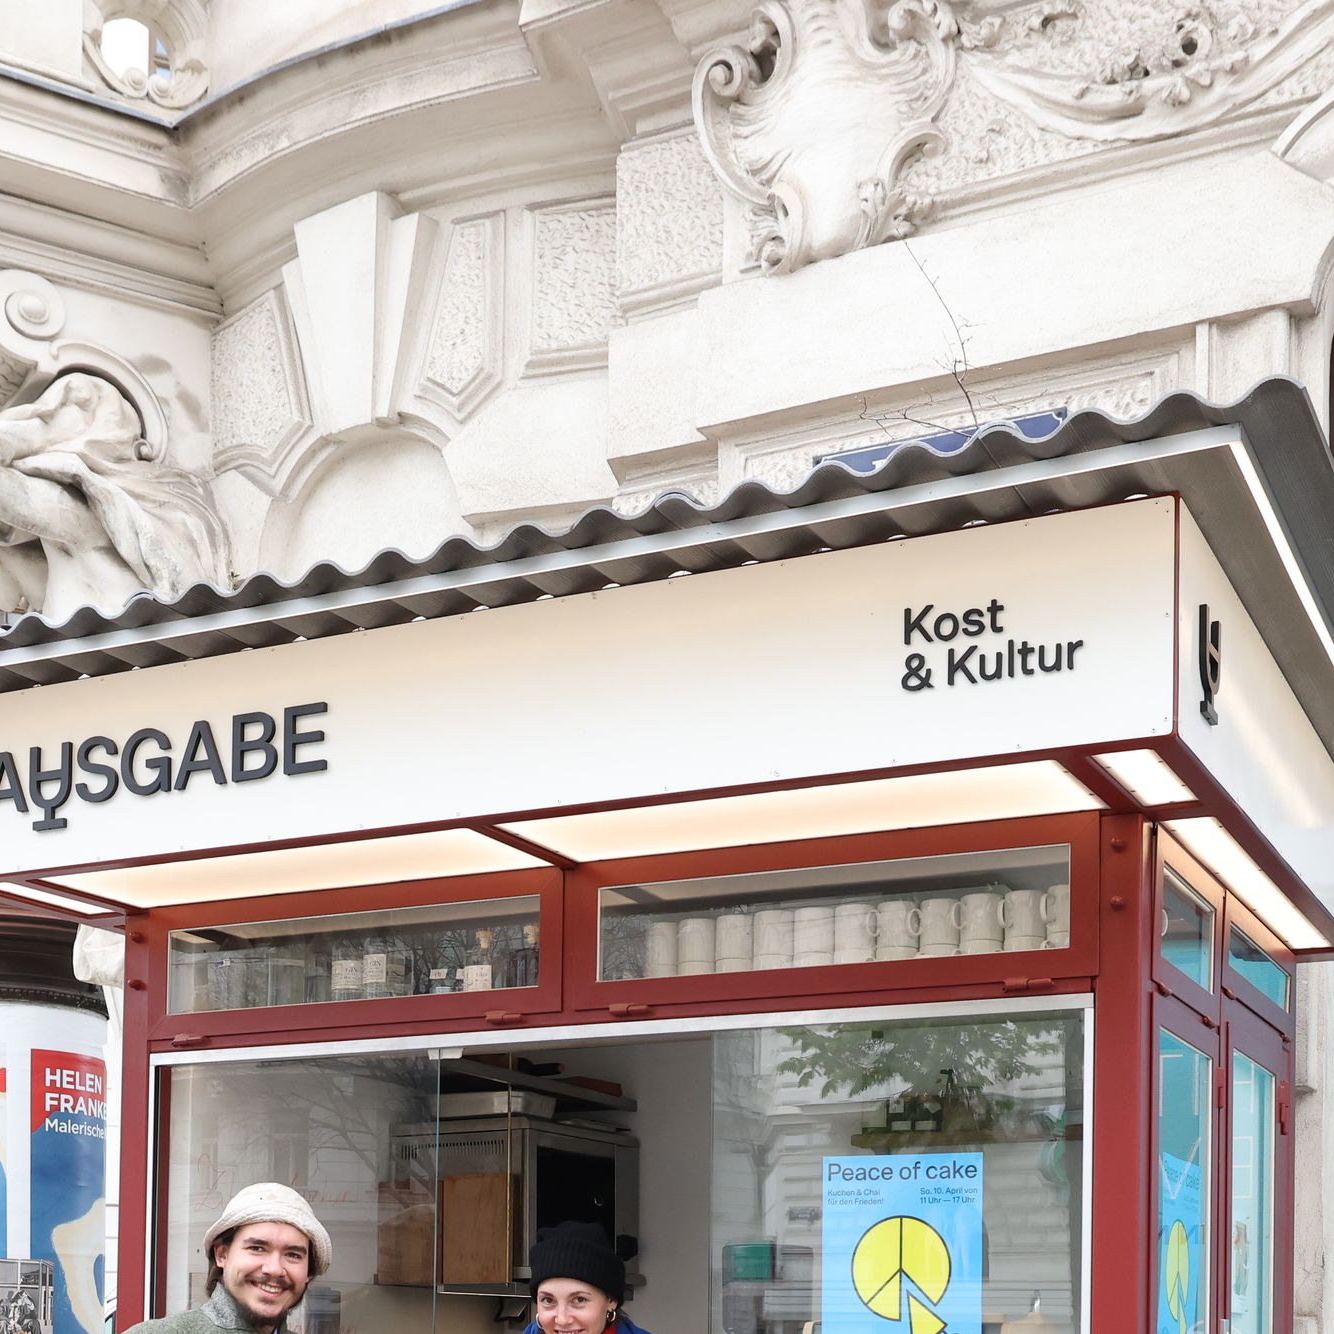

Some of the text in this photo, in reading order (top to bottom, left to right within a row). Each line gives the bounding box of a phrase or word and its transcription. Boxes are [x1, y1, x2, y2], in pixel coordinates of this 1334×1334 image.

[903, 598, 1005, 646] Kost
[900, 638, 1084, 693] & Kultur
[45, 1067, 102, 1095] HELEN
[45, 1117, 104, 1139] Malerische
[828, 1160, 978, 1182] Peace of cake
[827, 1189, 855, 1197] Kuchen
[827, 1197, 884, 1206] für den Frieden!
[920, 1187, 932, 1195] So.
[933, 1187, 944, 1195] 10.
[945, 1186, 963, 1196] April
[952, 1196, 960, 1204] 17
[961, 1196, 976, 1204] Uhr
